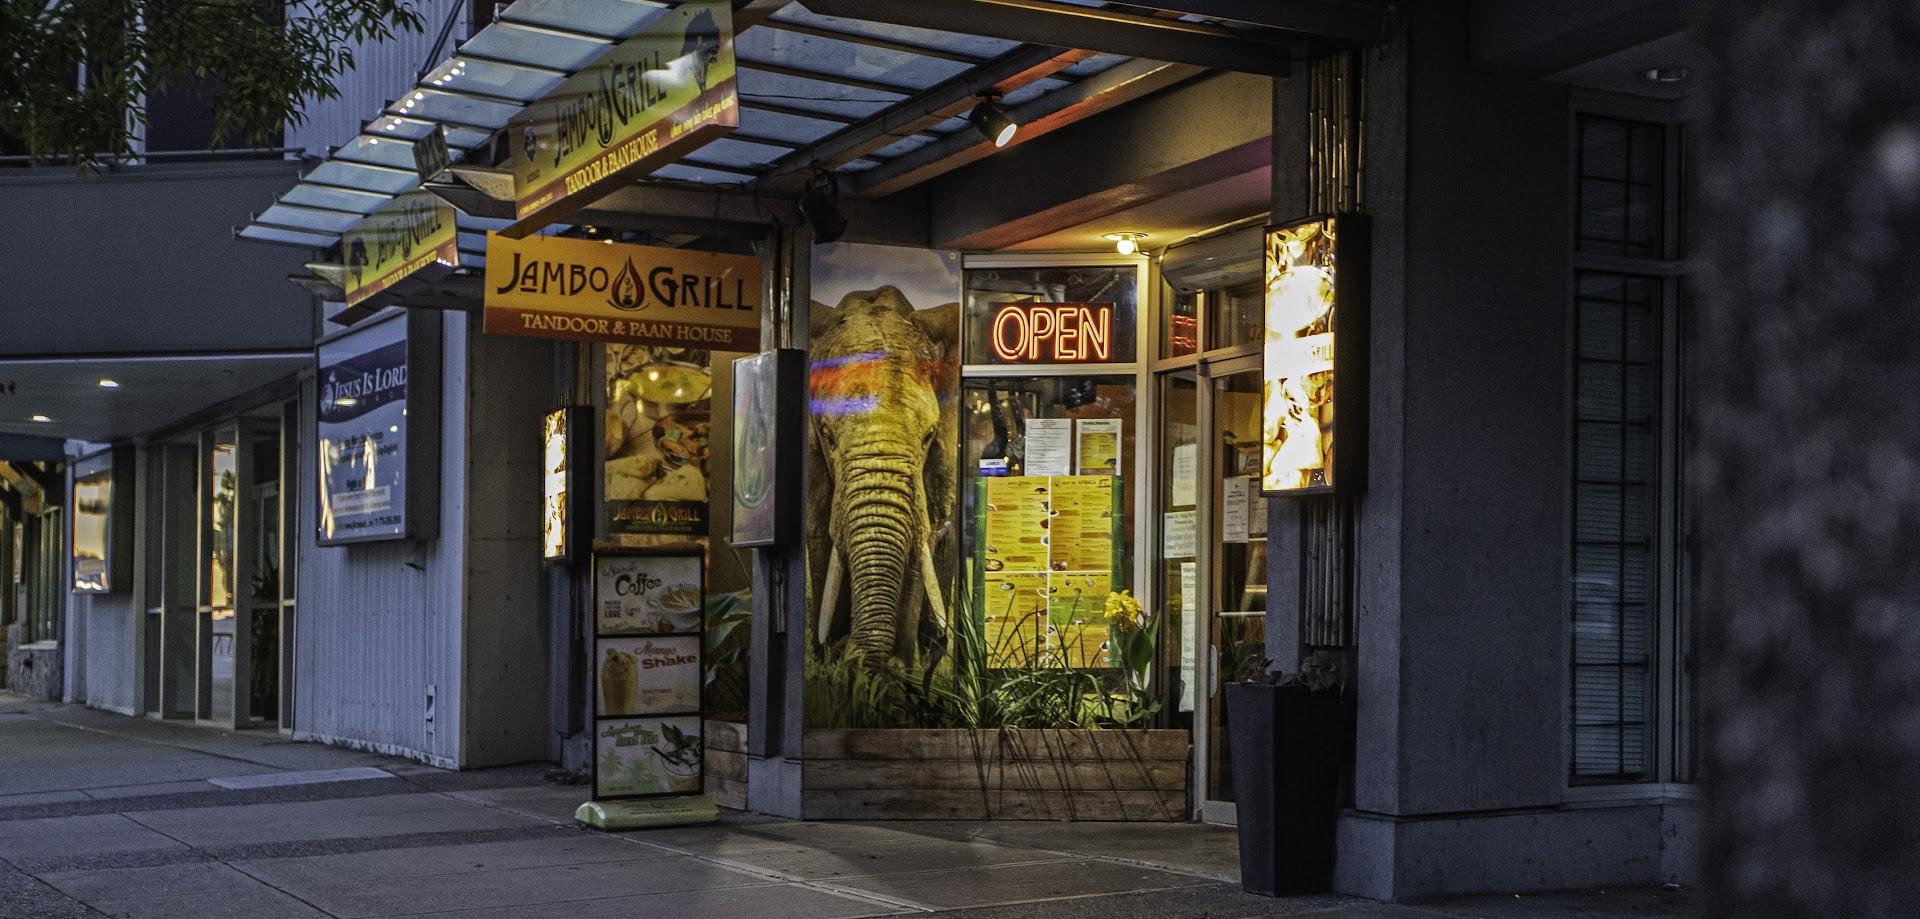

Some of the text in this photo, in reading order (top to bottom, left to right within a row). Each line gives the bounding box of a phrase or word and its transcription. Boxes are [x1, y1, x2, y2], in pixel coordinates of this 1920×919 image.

[554, 94, 596, 168] JAMBO
[612, 51, 667, 126] GRILL
[565, 160, 602, 195] TANDOOR
[629, 129, 658, 164] HOUSE
[497, 253, 753, 312] JAMBO GRILL
[521, 313, 733, 344] TANDOOR & PAAN HOUSE
[993, 306, 1109, 361] OPEN
[335, 378, 362, 402] JESUS
[362, 371, 374, 396] IS
[374, 365, 407, 392] LORD
[615, 573, 662, 596] Coffee
[642, 655, 697, 670] Shake
